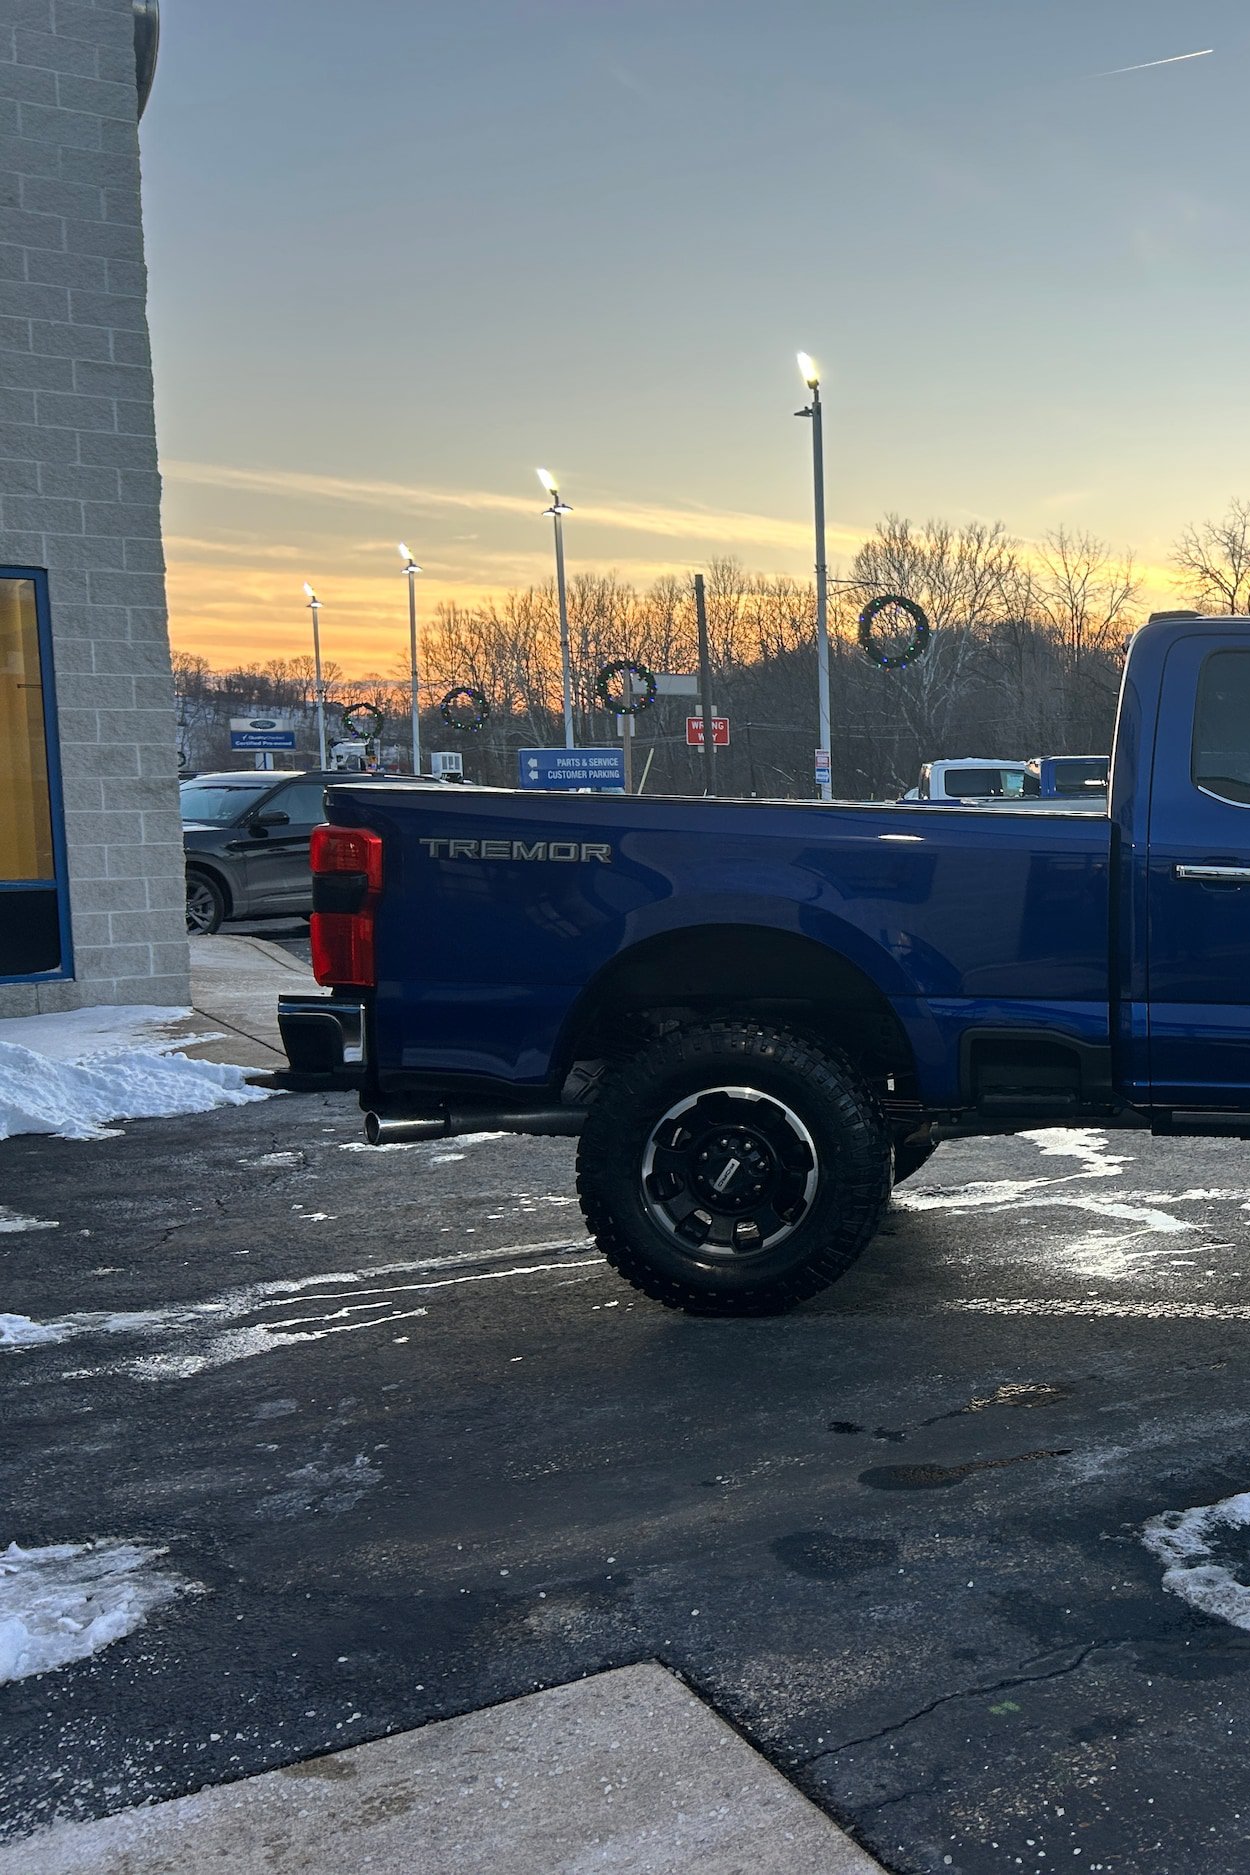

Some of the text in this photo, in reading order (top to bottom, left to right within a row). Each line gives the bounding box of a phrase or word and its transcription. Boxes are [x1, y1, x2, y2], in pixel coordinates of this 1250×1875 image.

[691, 722, 724, 730] WRNG
[697, 733, 718, 741] WY
[557, 757, 619, 767] PARTS & SERVICE
[547, 769, 620, 780] CUSTOMER PARKING
[418, 837, 612, 864] TREMOR
